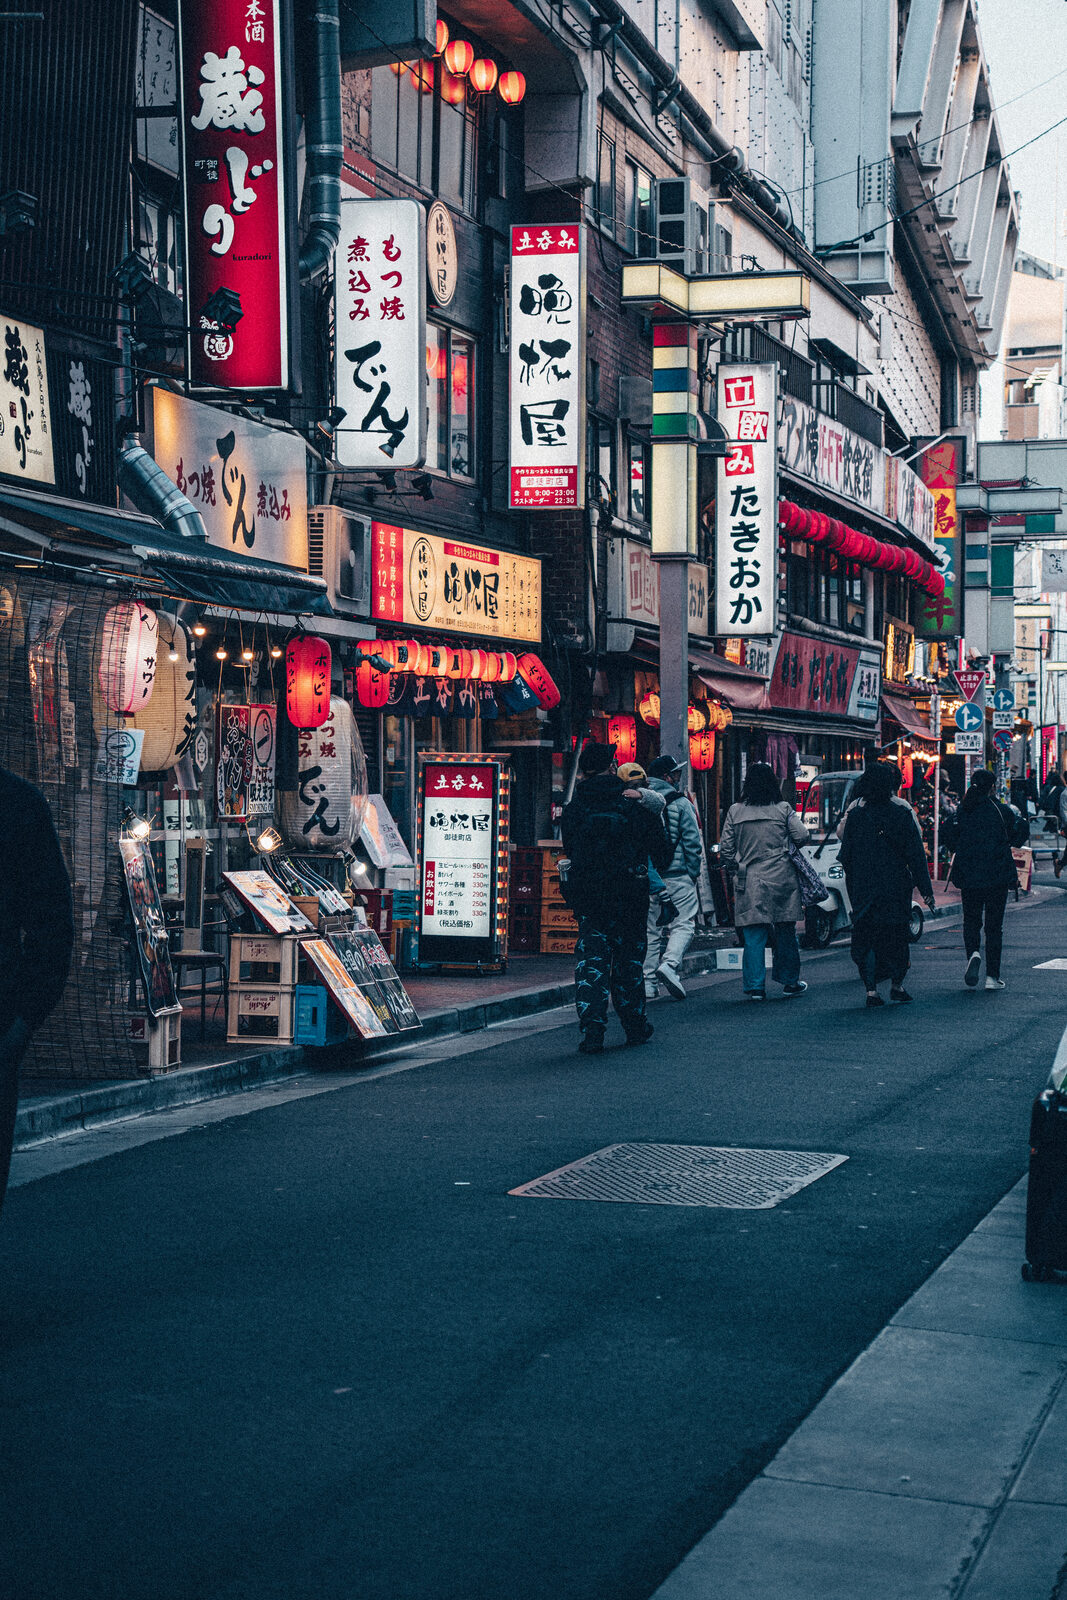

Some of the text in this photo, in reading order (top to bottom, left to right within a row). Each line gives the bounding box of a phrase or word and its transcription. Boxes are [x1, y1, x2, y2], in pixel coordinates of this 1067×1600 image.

[191, 45, 274, 256] 蔵どり
[232, 252, 272, 261] kuradori
[516, 230, 577, 252] 立呑み
[347, 235, 371, 321] 煮込み
[380, 234, 406, 321] もつ焼
[519, 274, 573, 447] 晩杯屋
[3, 325, 34, 470] 蔵どり
[344, 341, 410, 433] でん
[67, 360, 95, 495] 蔵どり
[725, 378, 768, 474] 立飲み
[176, 457, 217, 507] もつ焼
[215, 430, 256, 549] でん
[256, 480, 292, 522] 煮込み
[513, 497, 550, 505] ラストオーダー
[389, 531, 397, 616] 座り席あり
[729, 485, 763, 625] たきおか
[444, 562, 500, 620] 晩杯屋
[143, 656, 156, 698] サワー
[314, 655, 328, 714] ホッピー
[528, 665, 552, 701] ホッピー
[960, 674, 980, 682] 止まれ
[249, 783, 275, 802] 吸えます
[255, 766, 274, 784] たばこ
[433, 774, 485, 791] 立呑み
[249, 802, 268, 813] SMOKING
[298, 765, 340, 836] でん
[430, 812, 491, 833] 晩杯屋
[444, 833, 472, 842] 御徒町店
[425, 870, 435, 907] お飲み物
